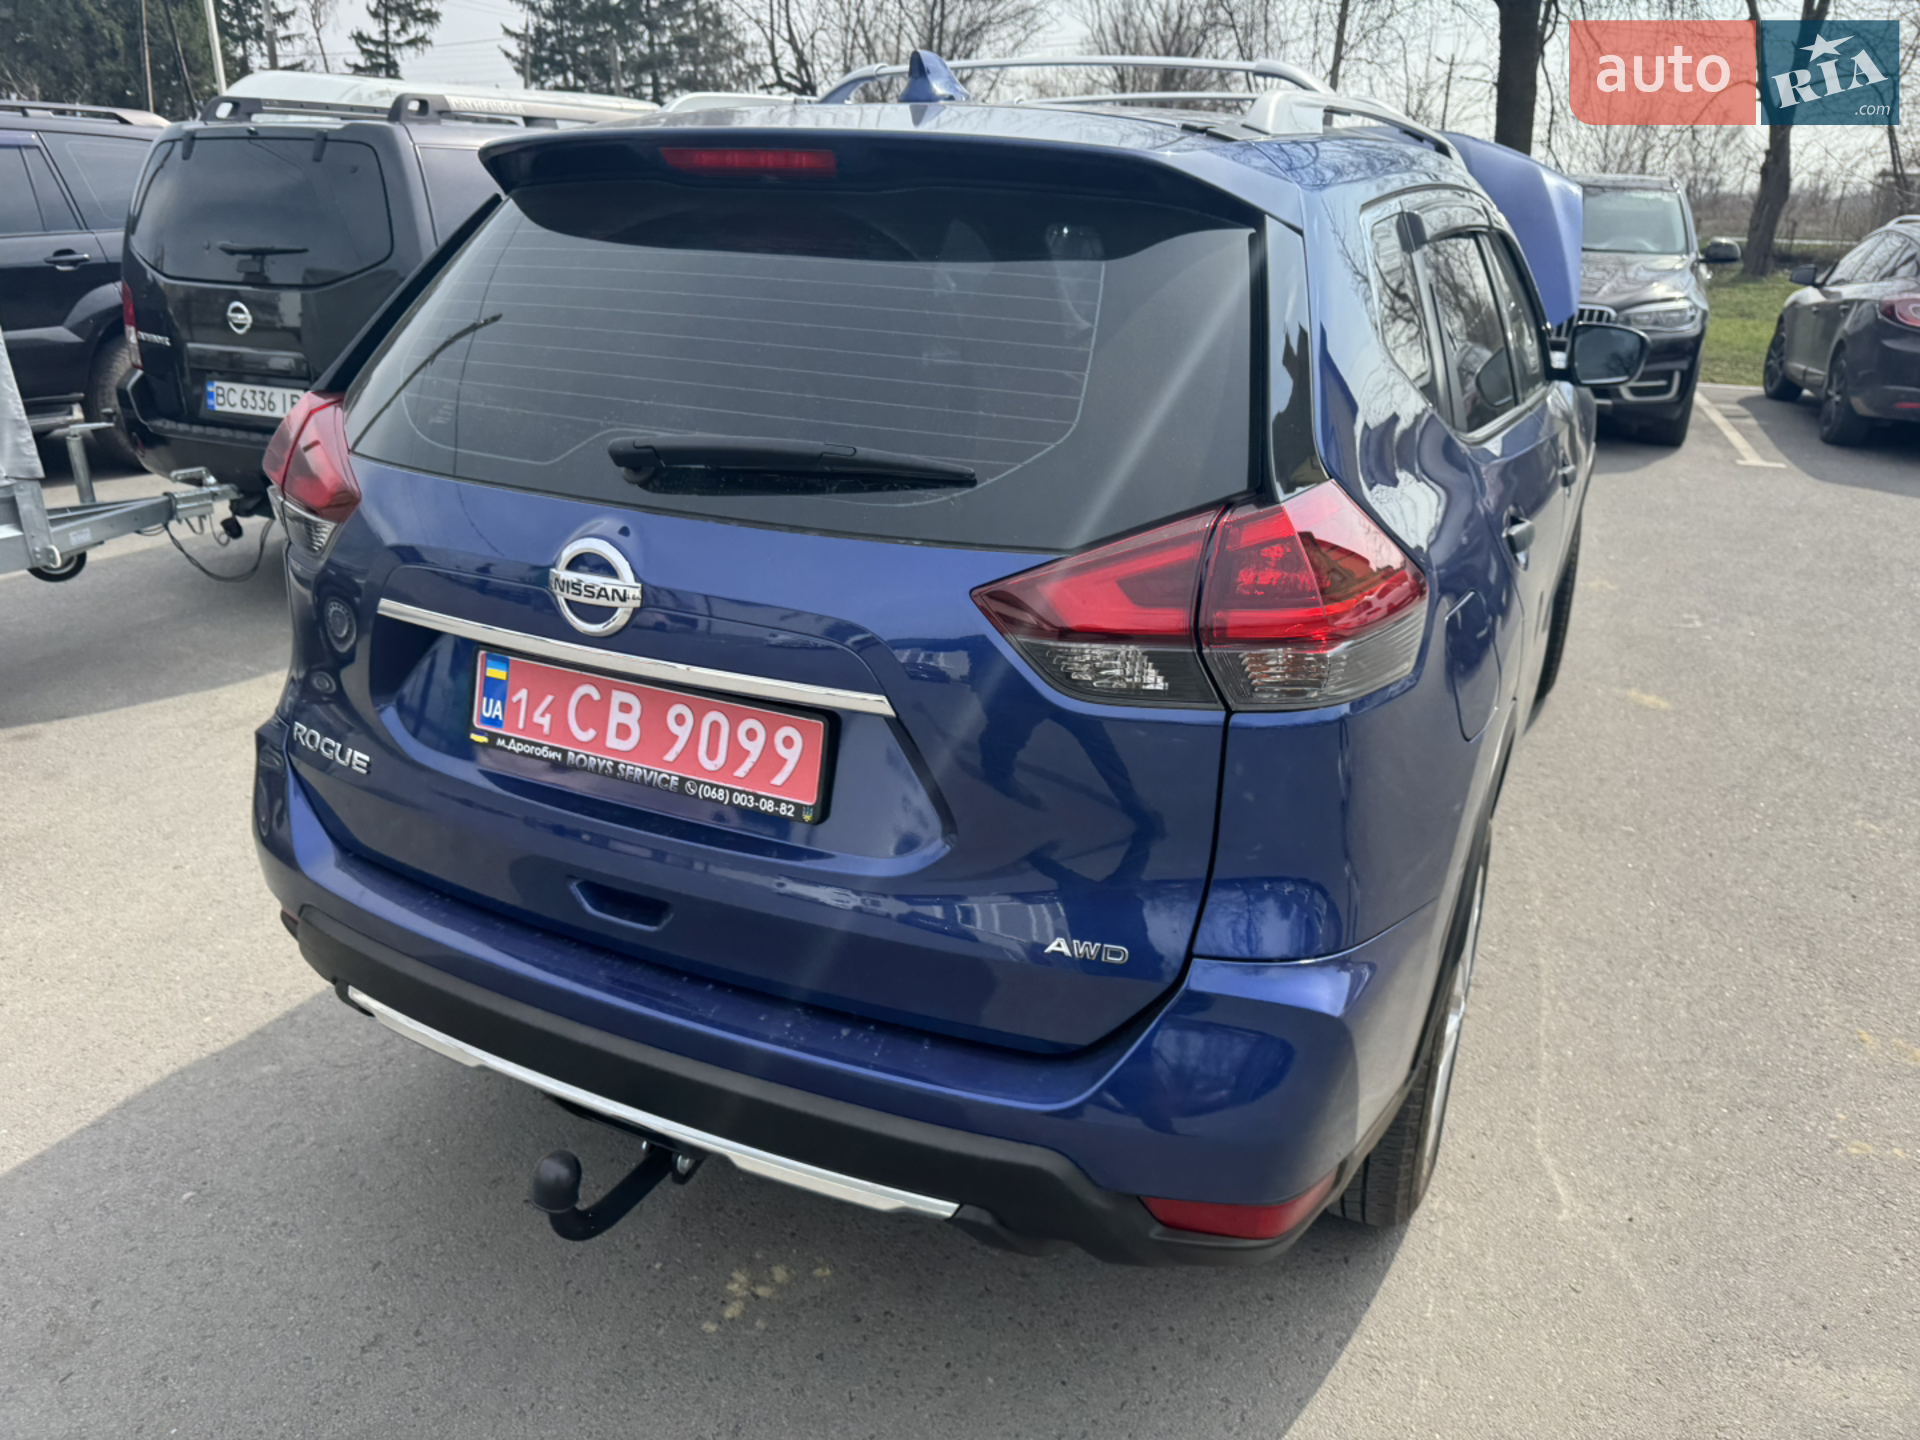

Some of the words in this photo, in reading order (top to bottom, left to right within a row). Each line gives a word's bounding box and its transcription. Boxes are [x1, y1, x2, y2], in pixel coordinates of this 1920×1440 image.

[215, 385, 238, 408] BC
[240, 389, 276, 413] 6336
[554, 577, 627, 603] NISSAN
[481, 696, 503, 721] UA
[293, 720, 371, 775] ROGUE
[511, 688, 555, 736] 14
[567, 684, 642, 752] CB
[662, 703, 804, 787] 9099
[566, 751, 614, 776] BORYS
[617, 763, 680, 793] SERVICE
[698, 783, 730, 805] (068)
[732, 792, 796, 818] 003-08-82
[1043, 936, 1129, 965] AWD
